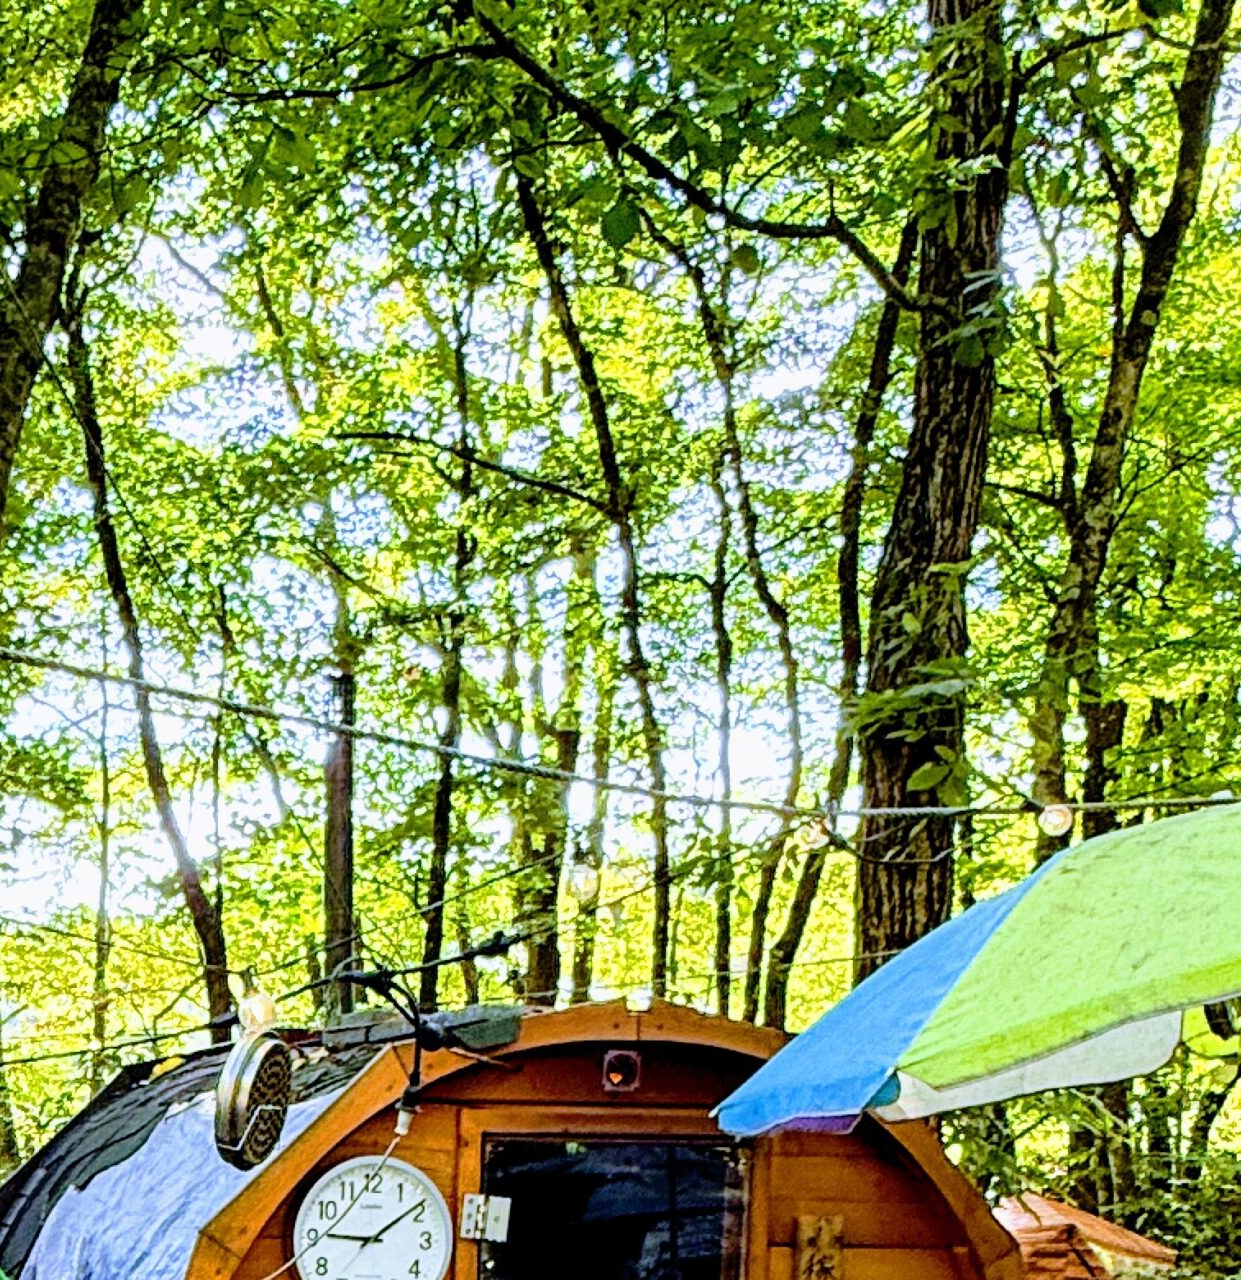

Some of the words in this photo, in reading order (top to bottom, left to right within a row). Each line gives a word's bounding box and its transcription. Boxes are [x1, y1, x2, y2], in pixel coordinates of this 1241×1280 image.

[339, 1181, 355, 1201] 11
[364, 1173, 383, 1194] 12
[397, 1183, 404, 1203] 1
[318, 1200, 337, 1220] 10
[412, 1201, 425, 1223] 2
[306, 1228, 319, 1247] 9
[419, 1231, 433, 1251] 3
[315, 1256, 329, 1276] 8
[408, 1259, 421, 1279] 4
